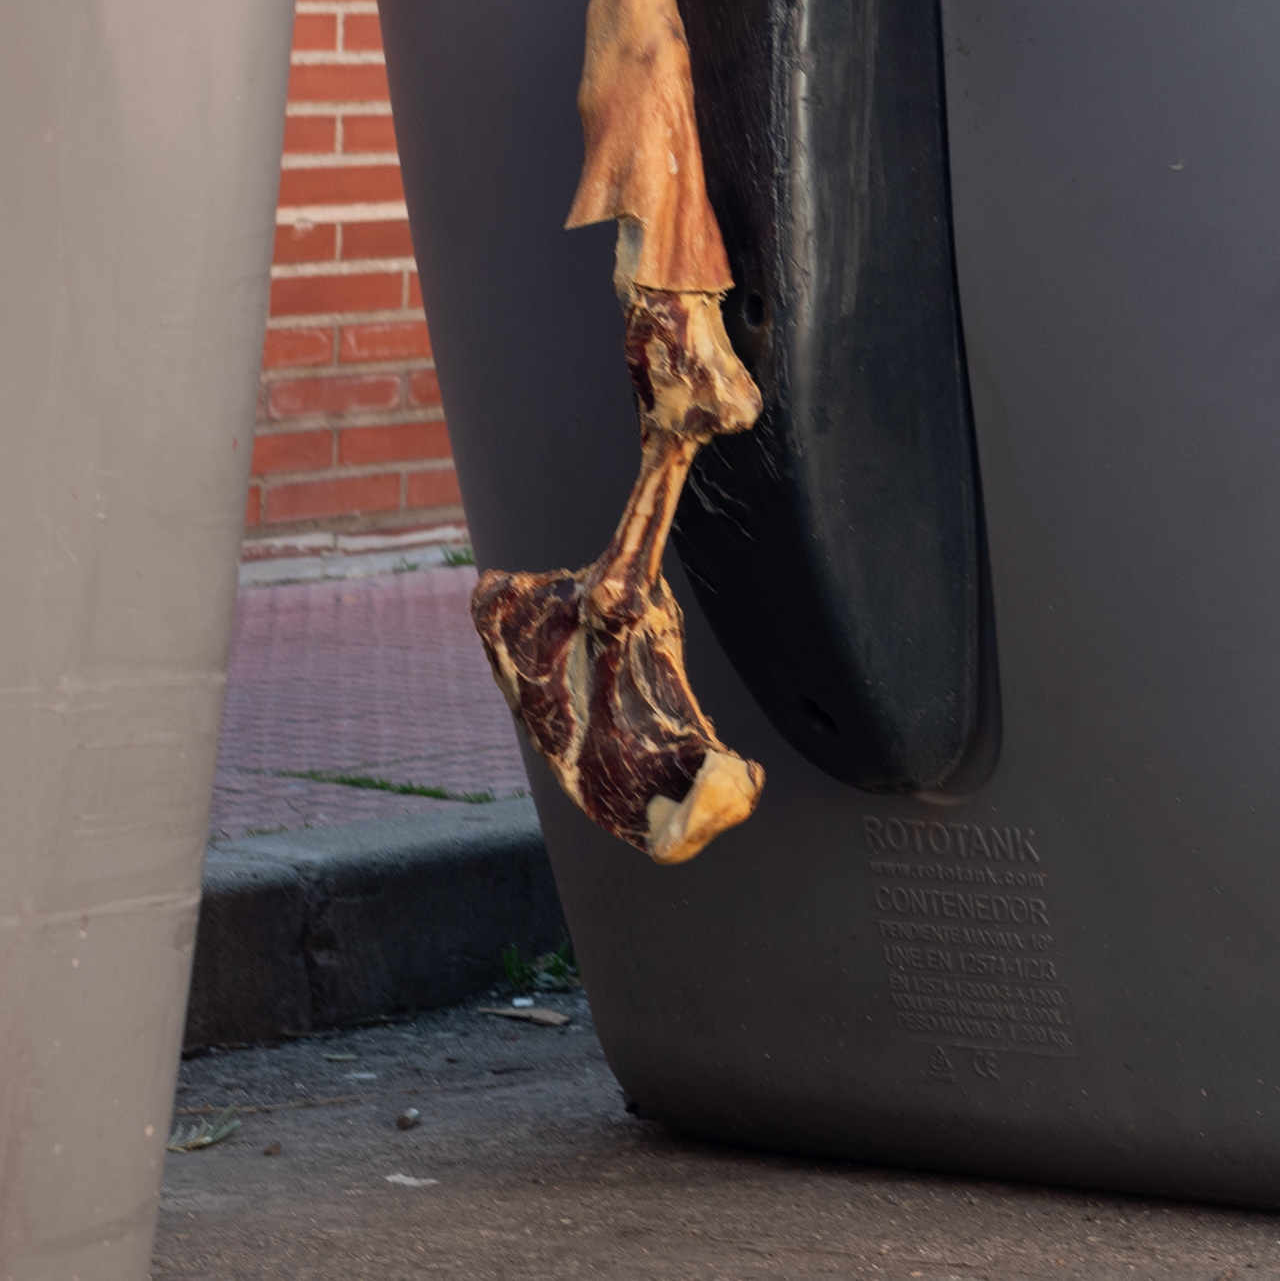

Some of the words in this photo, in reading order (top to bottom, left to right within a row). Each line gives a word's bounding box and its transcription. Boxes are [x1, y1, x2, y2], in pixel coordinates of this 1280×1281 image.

[861, 814, 1042, 864] ROTOTANK
[868, 858, 1046, 889] www.rototank.com
[874, 884, 1051, 927] CONTENEDOR
[882, 944, 924, 969] UNE
[925, 948, 953, 973] EN
